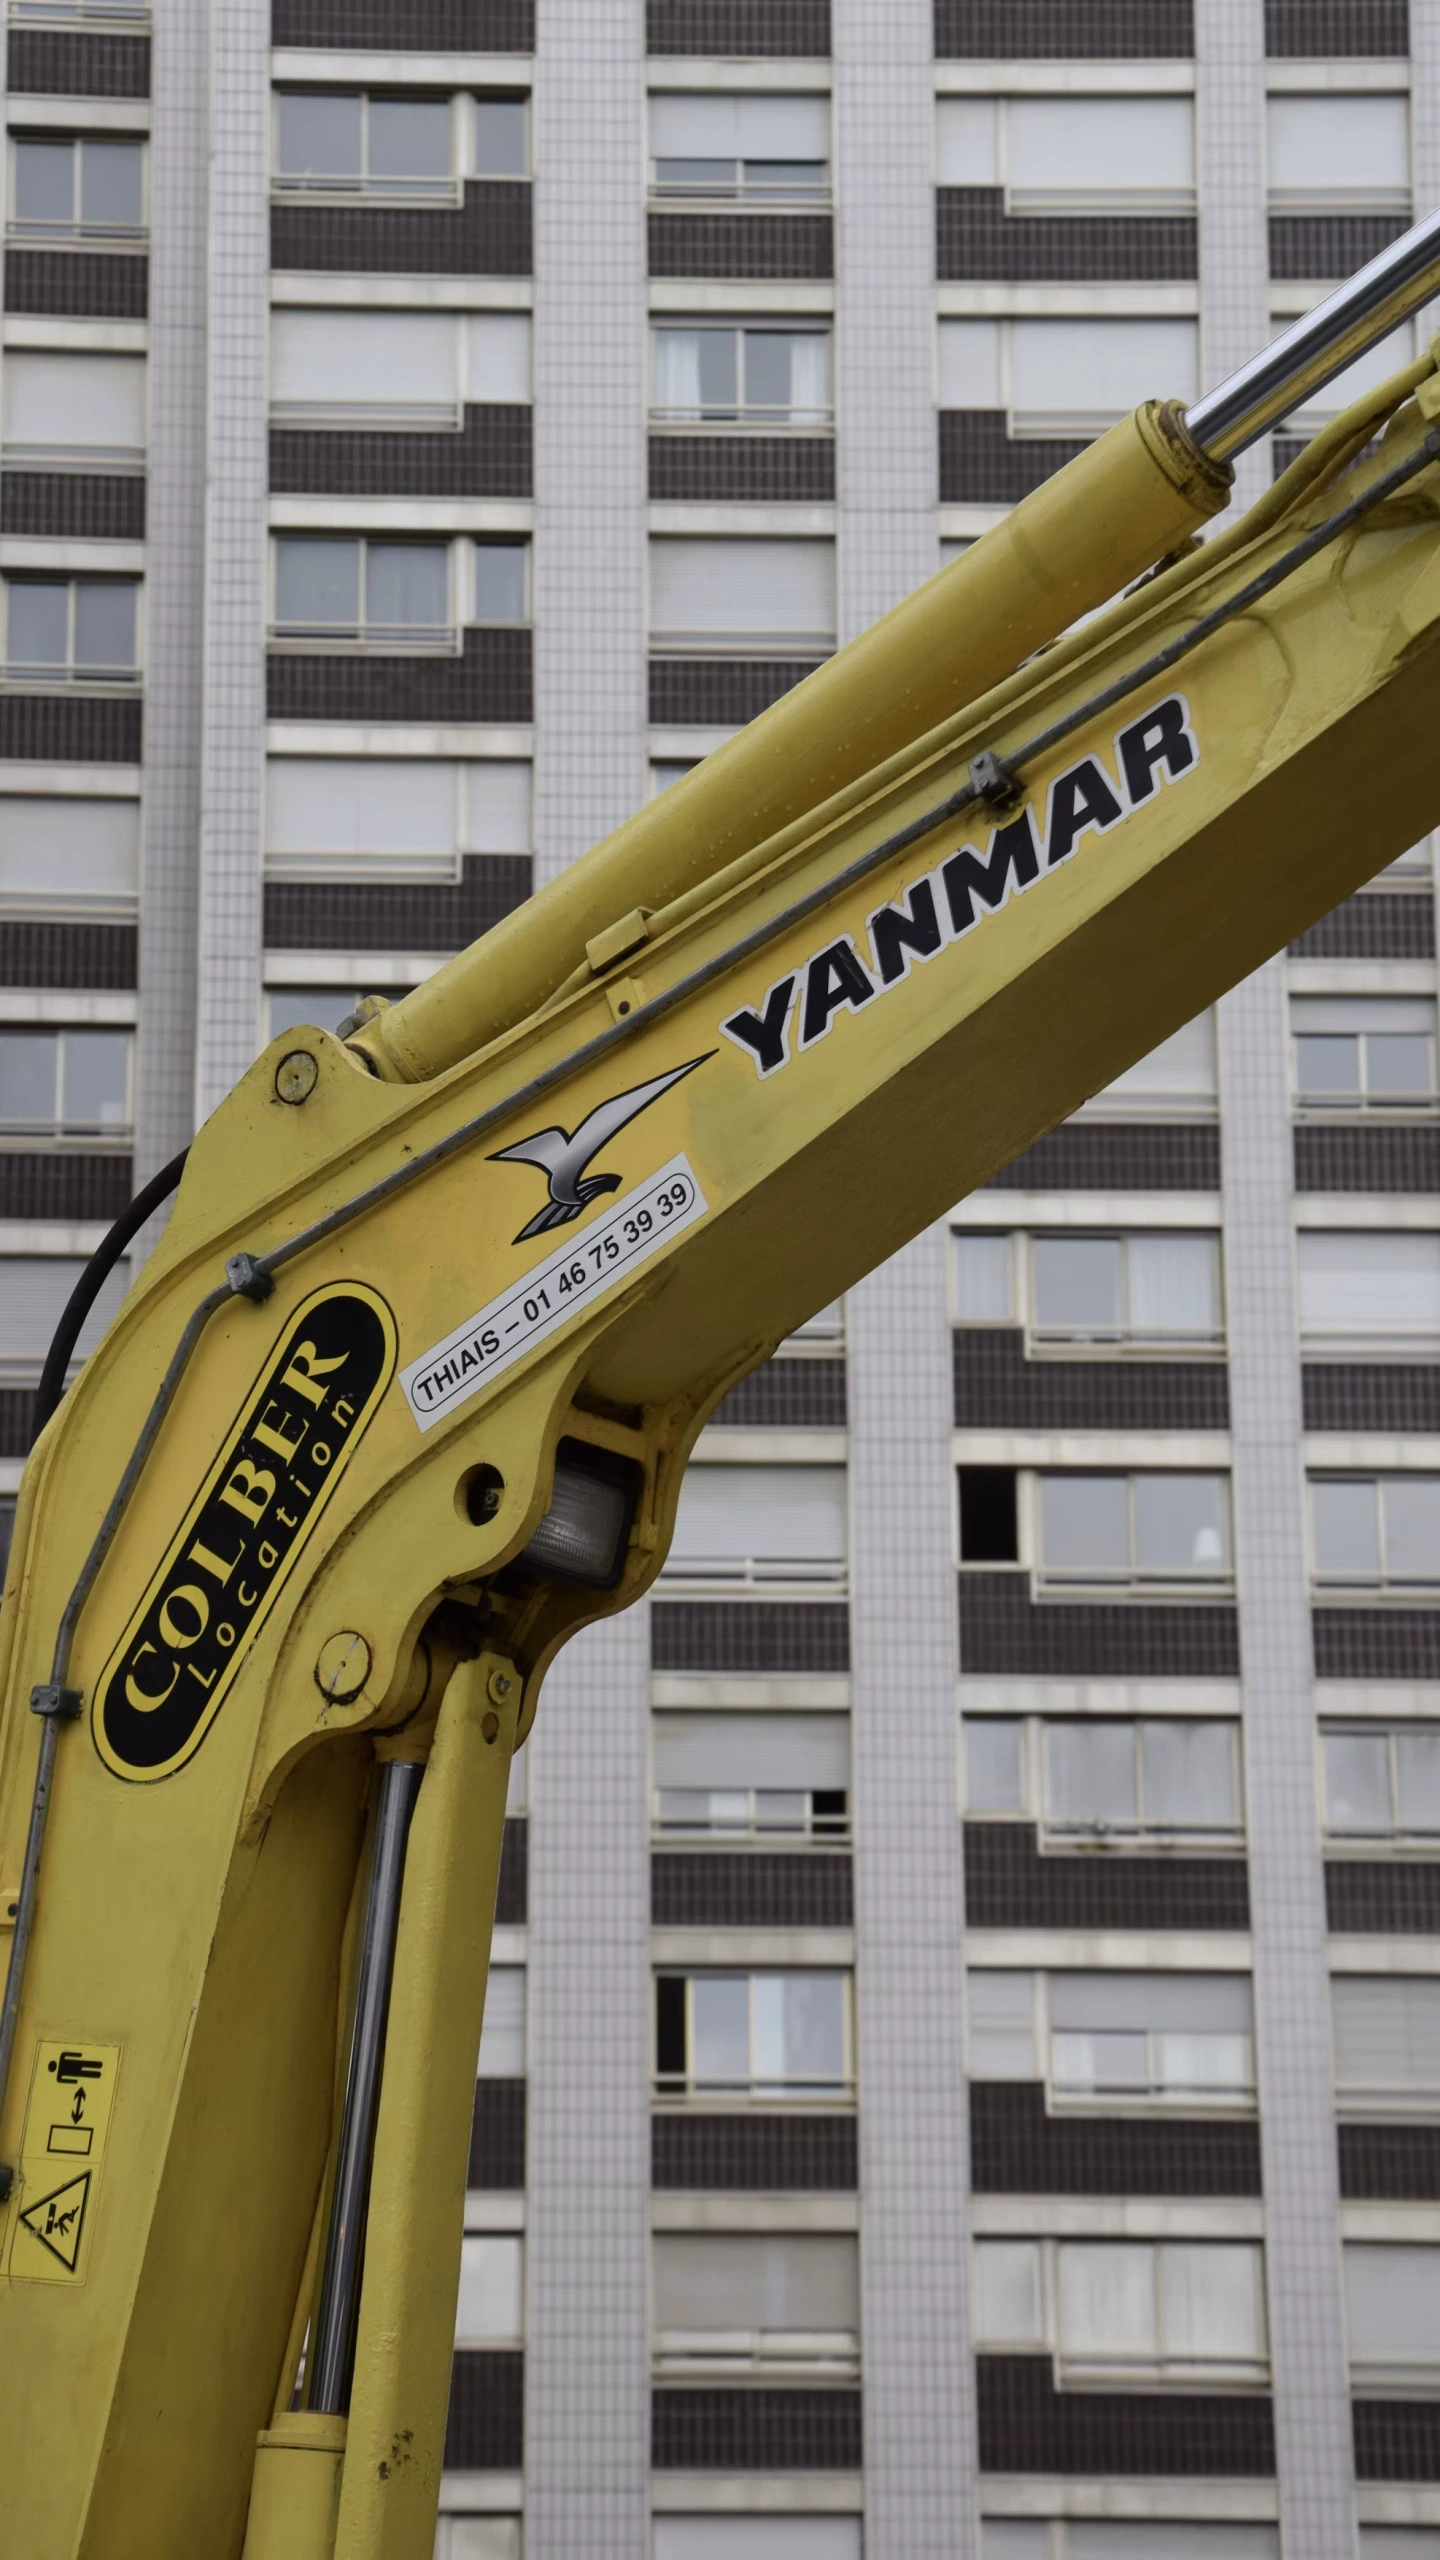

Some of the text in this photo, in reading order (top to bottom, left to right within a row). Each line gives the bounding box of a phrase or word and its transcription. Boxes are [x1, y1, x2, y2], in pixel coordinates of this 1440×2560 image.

[723, 698, 1196, 1074] YANMAR
[417, 1329, 500, 1401] THIAIS
[523, 1289, 551, 1322] 01
[558, 1262, 586, 1294] 46
[588, 1235, 620, 1269] 75
[623, 1209, 653, 1244] 39
[656, 1183, 687, 1217] 39
[125, 1339, 351, 1713] COLBER
[187, 1399, 355, 1689] Location
